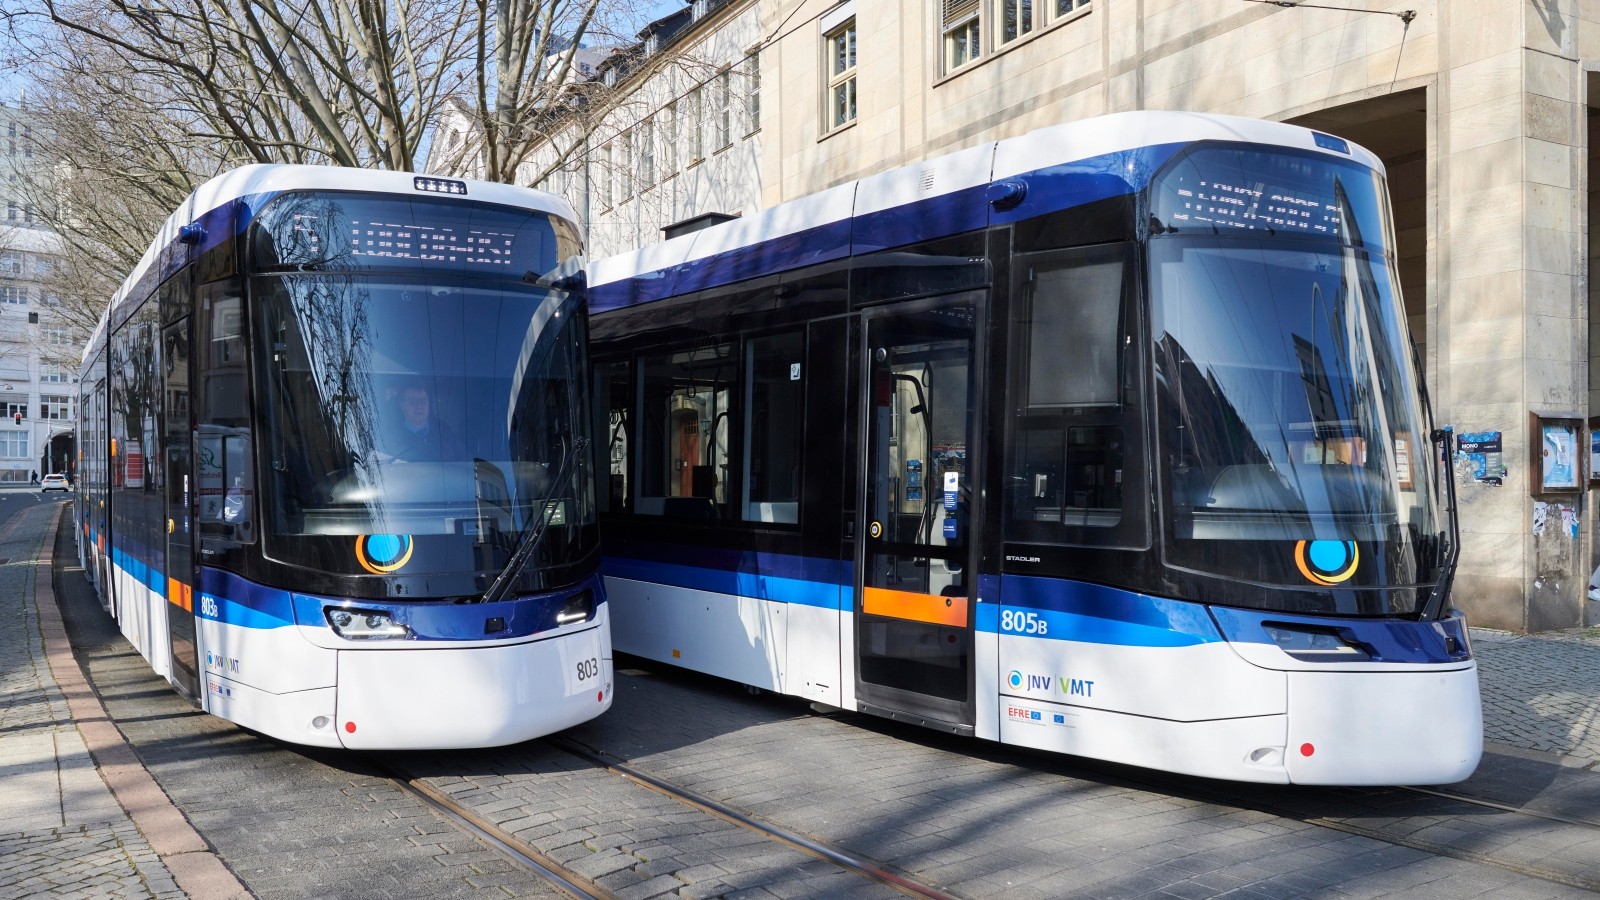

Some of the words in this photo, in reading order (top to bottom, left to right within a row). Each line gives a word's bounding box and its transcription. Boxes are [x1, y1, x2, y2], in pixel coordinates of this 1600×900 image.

[1006, 555, 1041, 563] STADLER
[1001, 609, 1048, 635] 805B
[576, 657, 599, 681] 803
[1027, 674, 1051, 692] JNV
[1060, 676, 1095, 698] VMT
[1008, 707, 1030, 719] EFRE
